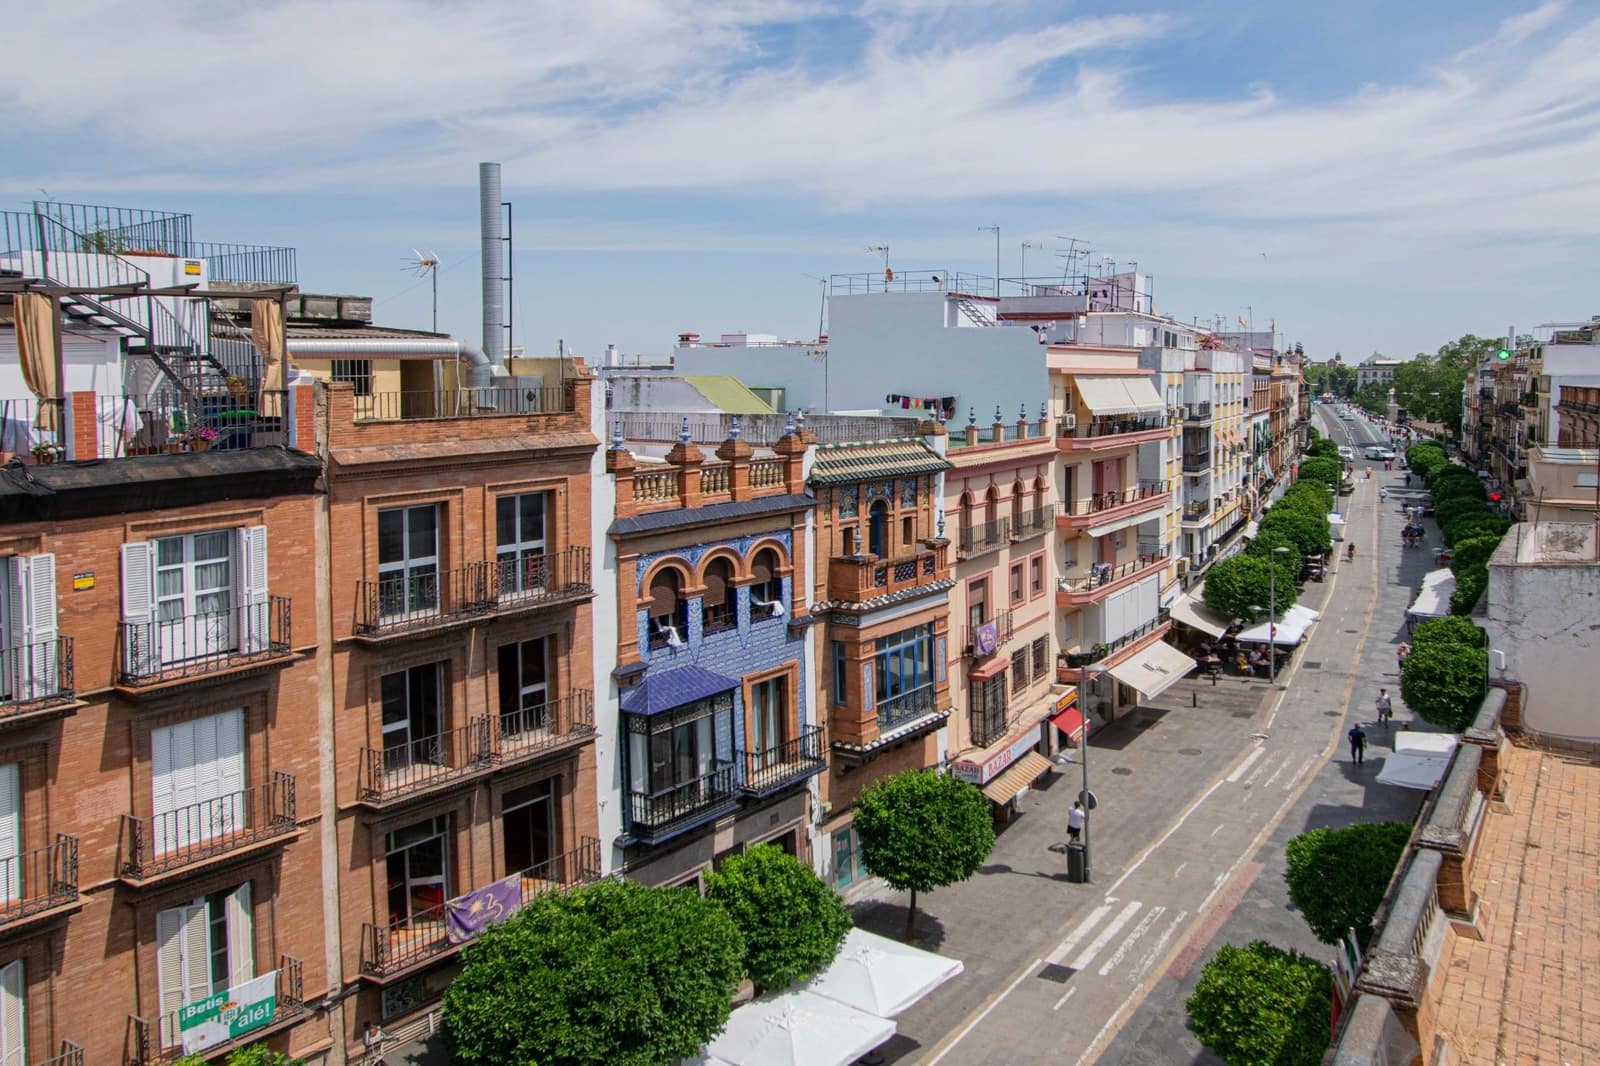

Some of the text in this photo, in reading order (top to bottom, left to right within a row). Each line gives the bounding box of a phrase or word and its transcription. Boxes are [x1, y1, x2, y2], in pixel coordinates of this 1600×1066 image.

[955, 764, 980, 774] BAZAR
[988, 750, 1012, 777] BAZAR
[238, 1003, 270, 1028] alé!
